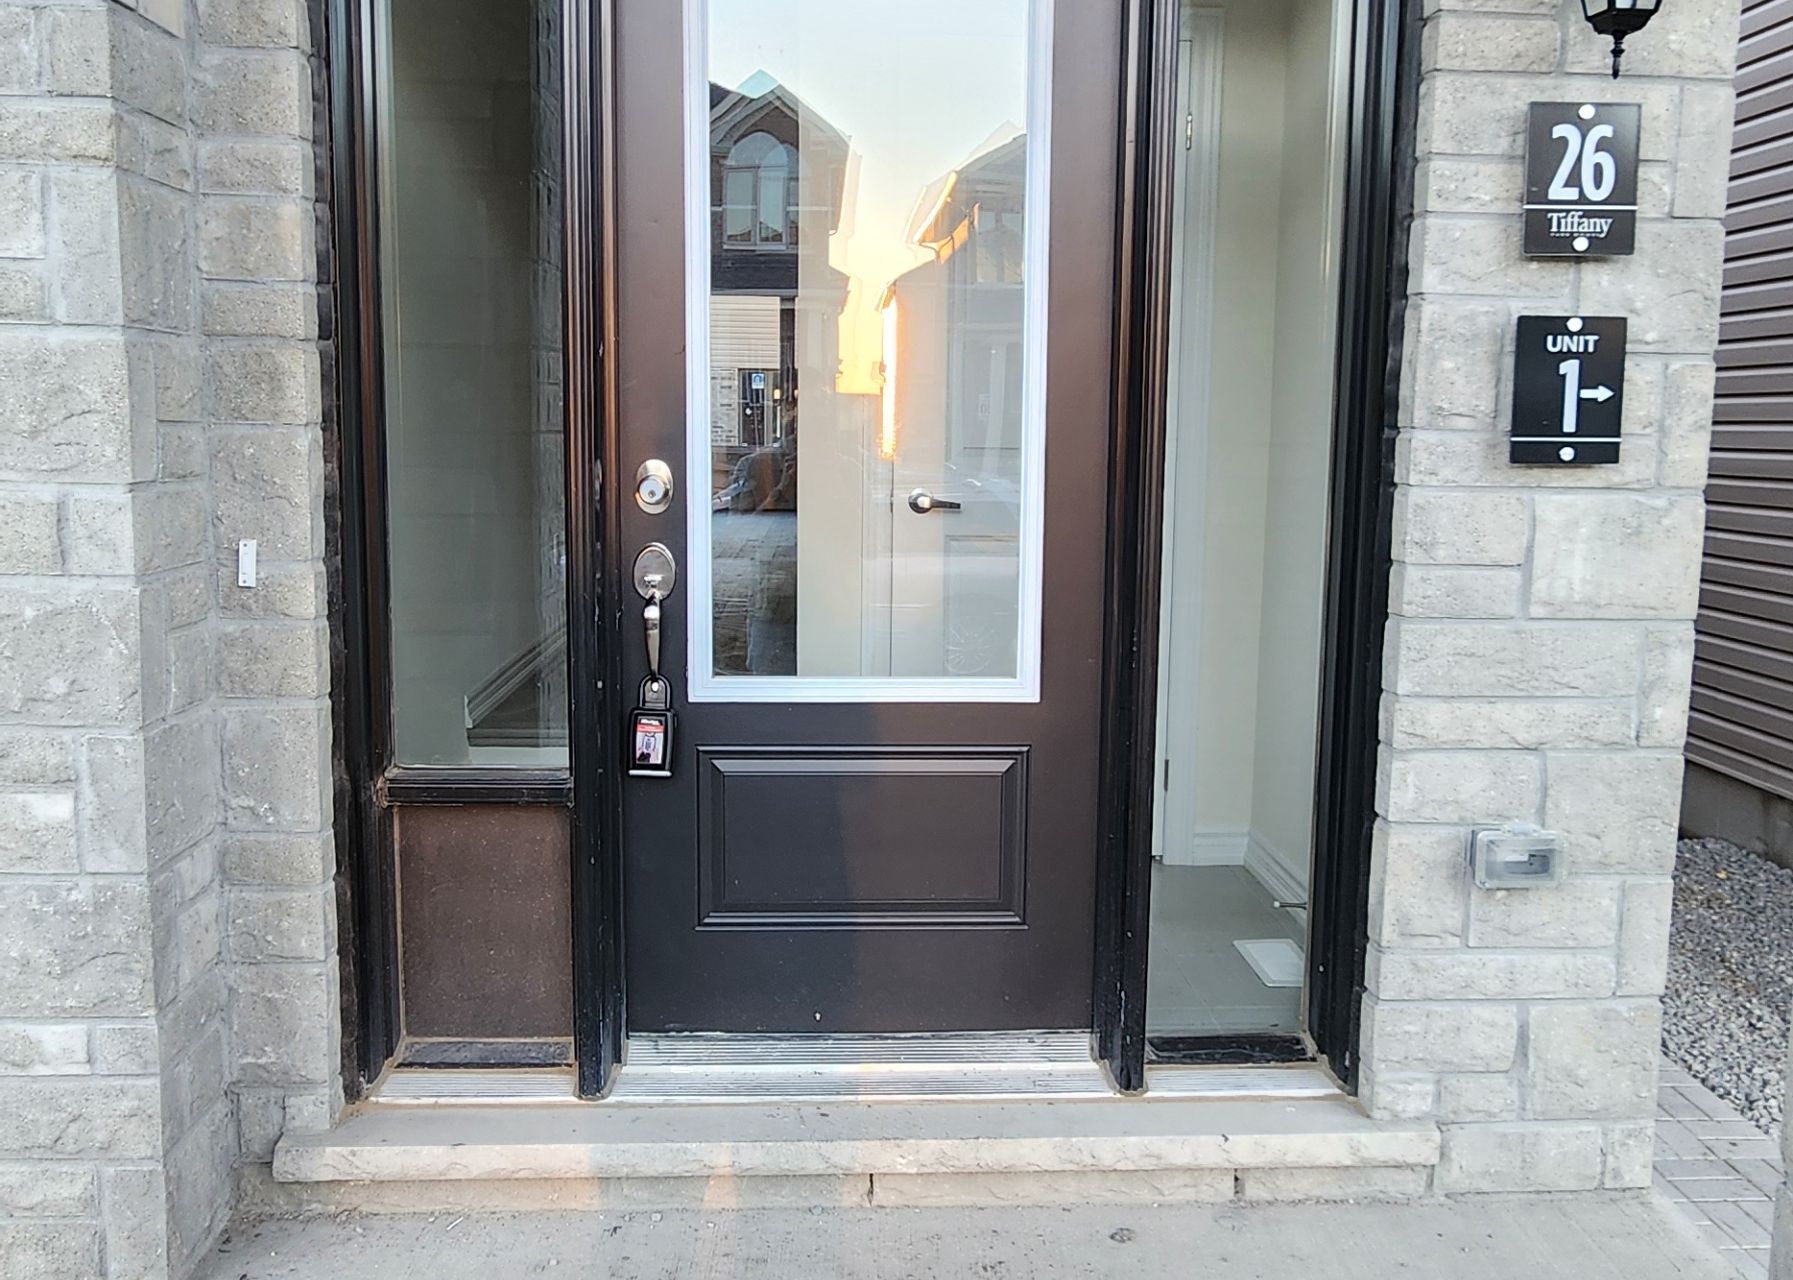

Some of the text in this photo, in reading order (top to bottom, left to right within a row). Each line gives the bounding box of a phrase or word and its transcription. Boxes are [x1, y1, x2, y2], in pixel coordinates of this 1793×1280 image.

[1547, 123, 1616, 202] 26
[1547, 211, 1613, 238] Tiffany
[1546, 335, 1599, 353] UNIT
[1559, 359, 1580, 433] 1
